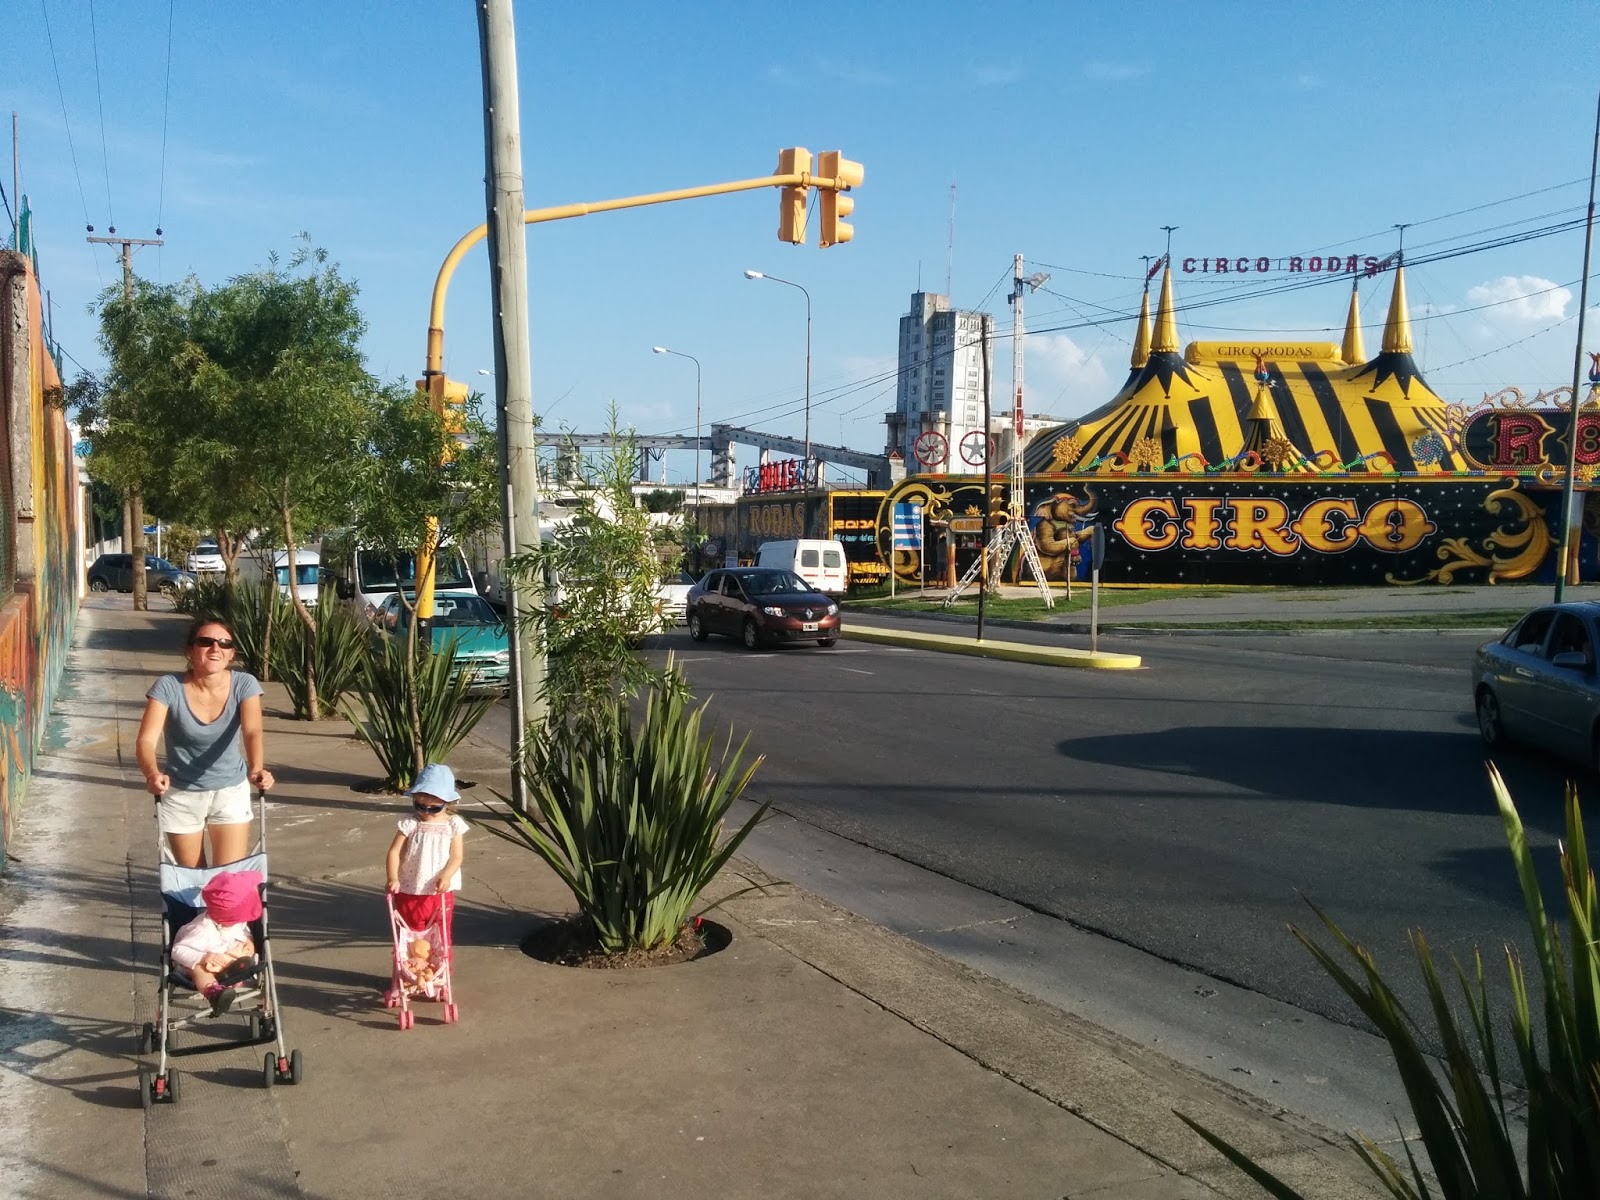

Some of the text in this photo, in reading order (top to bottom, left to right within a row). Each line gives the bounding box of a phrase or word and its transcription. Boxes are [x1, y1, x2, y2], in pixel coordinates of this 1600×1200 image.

[1182, 256, 1270, 273] CIRCO
[1289, 255, 1379, 274] RODAS
[1217, 346, 1313, 357] CIRCO RODAS
[749, 502, 806, 540] RODAS
[1112, 496, 1438, 557] CIRCO
